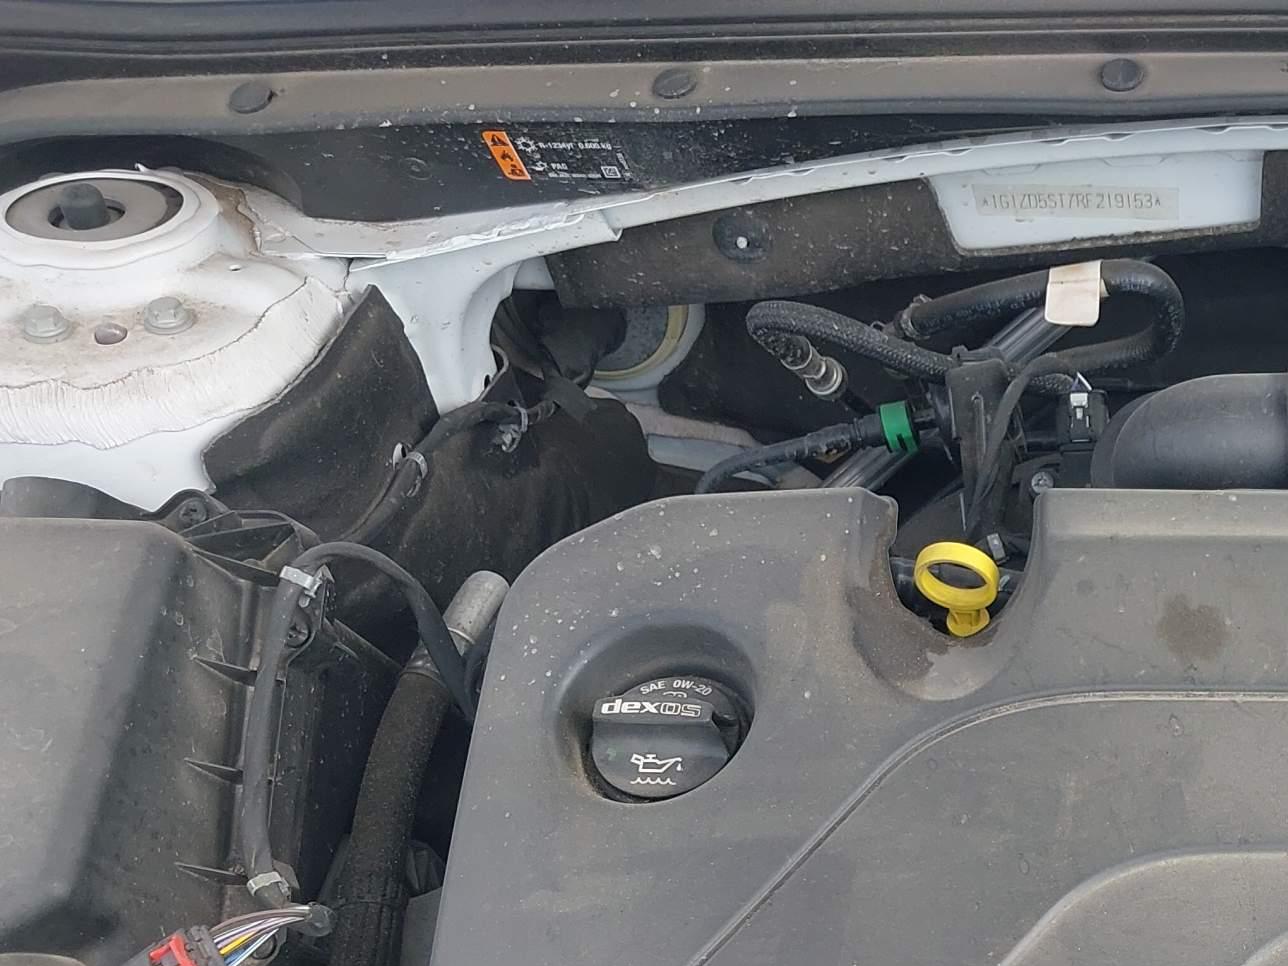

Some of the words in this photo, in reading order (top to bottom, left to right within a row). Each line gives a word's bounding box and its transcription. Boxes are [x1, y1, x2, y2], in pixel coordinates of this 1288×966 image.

[640, 680, 666, 695] SAE
[673, 679, 713, 696] 0W-20
[601, 699, 702, 717] dexos
